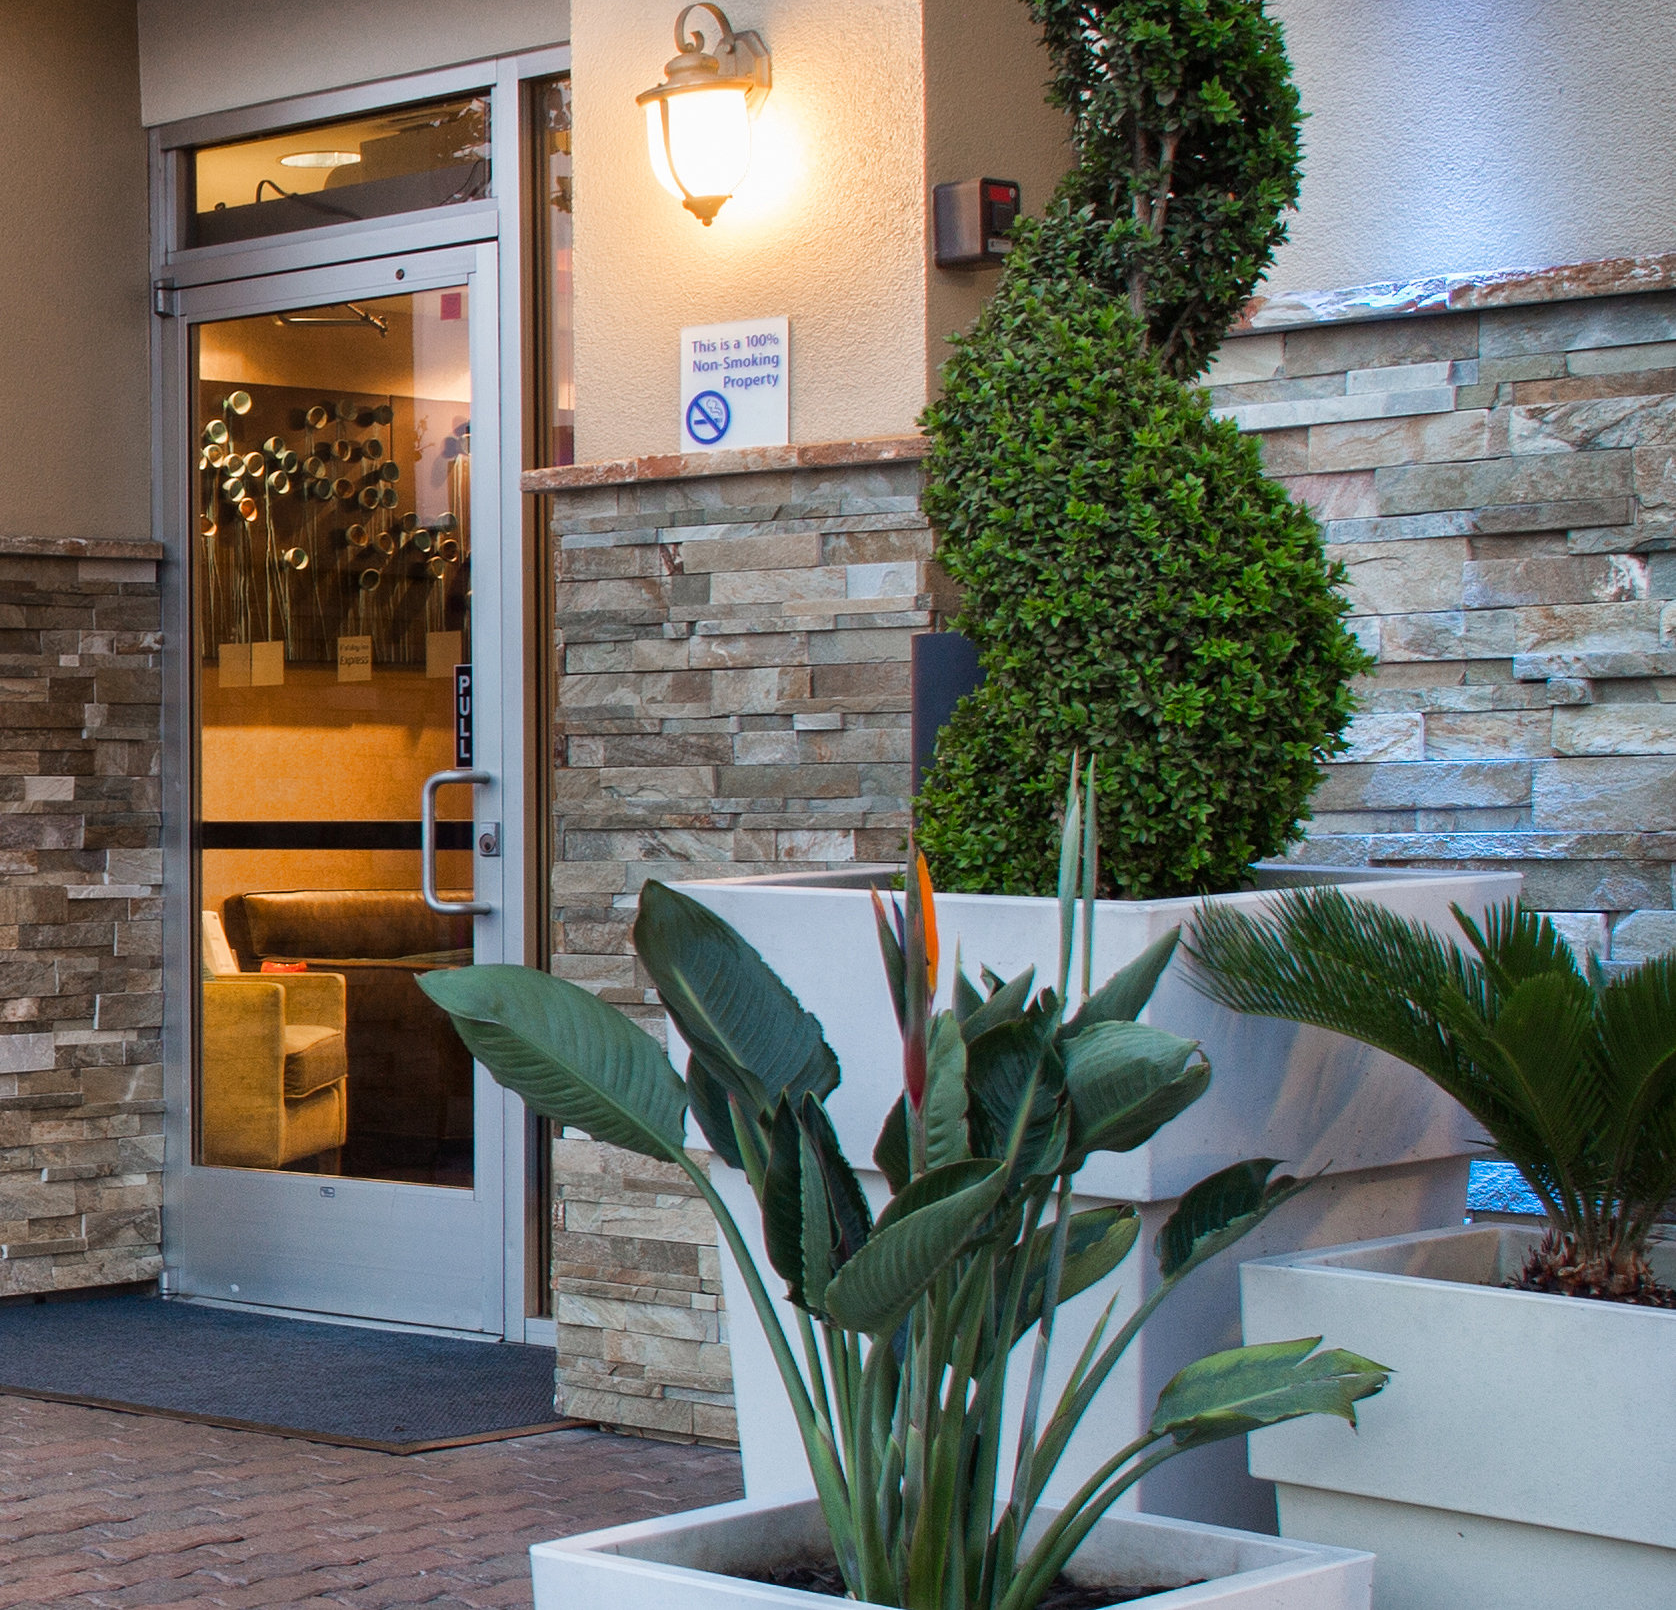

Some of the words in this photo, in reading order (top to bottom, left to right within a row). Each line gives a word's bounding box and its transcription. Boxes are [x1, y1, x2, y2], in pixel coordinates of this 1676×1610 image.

[691, 340, 716, 354] This
[720, 338, 730, 352] is
[733, 339, 741, 350] a
[746, 333, 779, 348] 100%
[693, 353, 779, 373] Non-Smoking
[723, 374, 779, 389] Property
[458, 674, 471, 758] PULL
